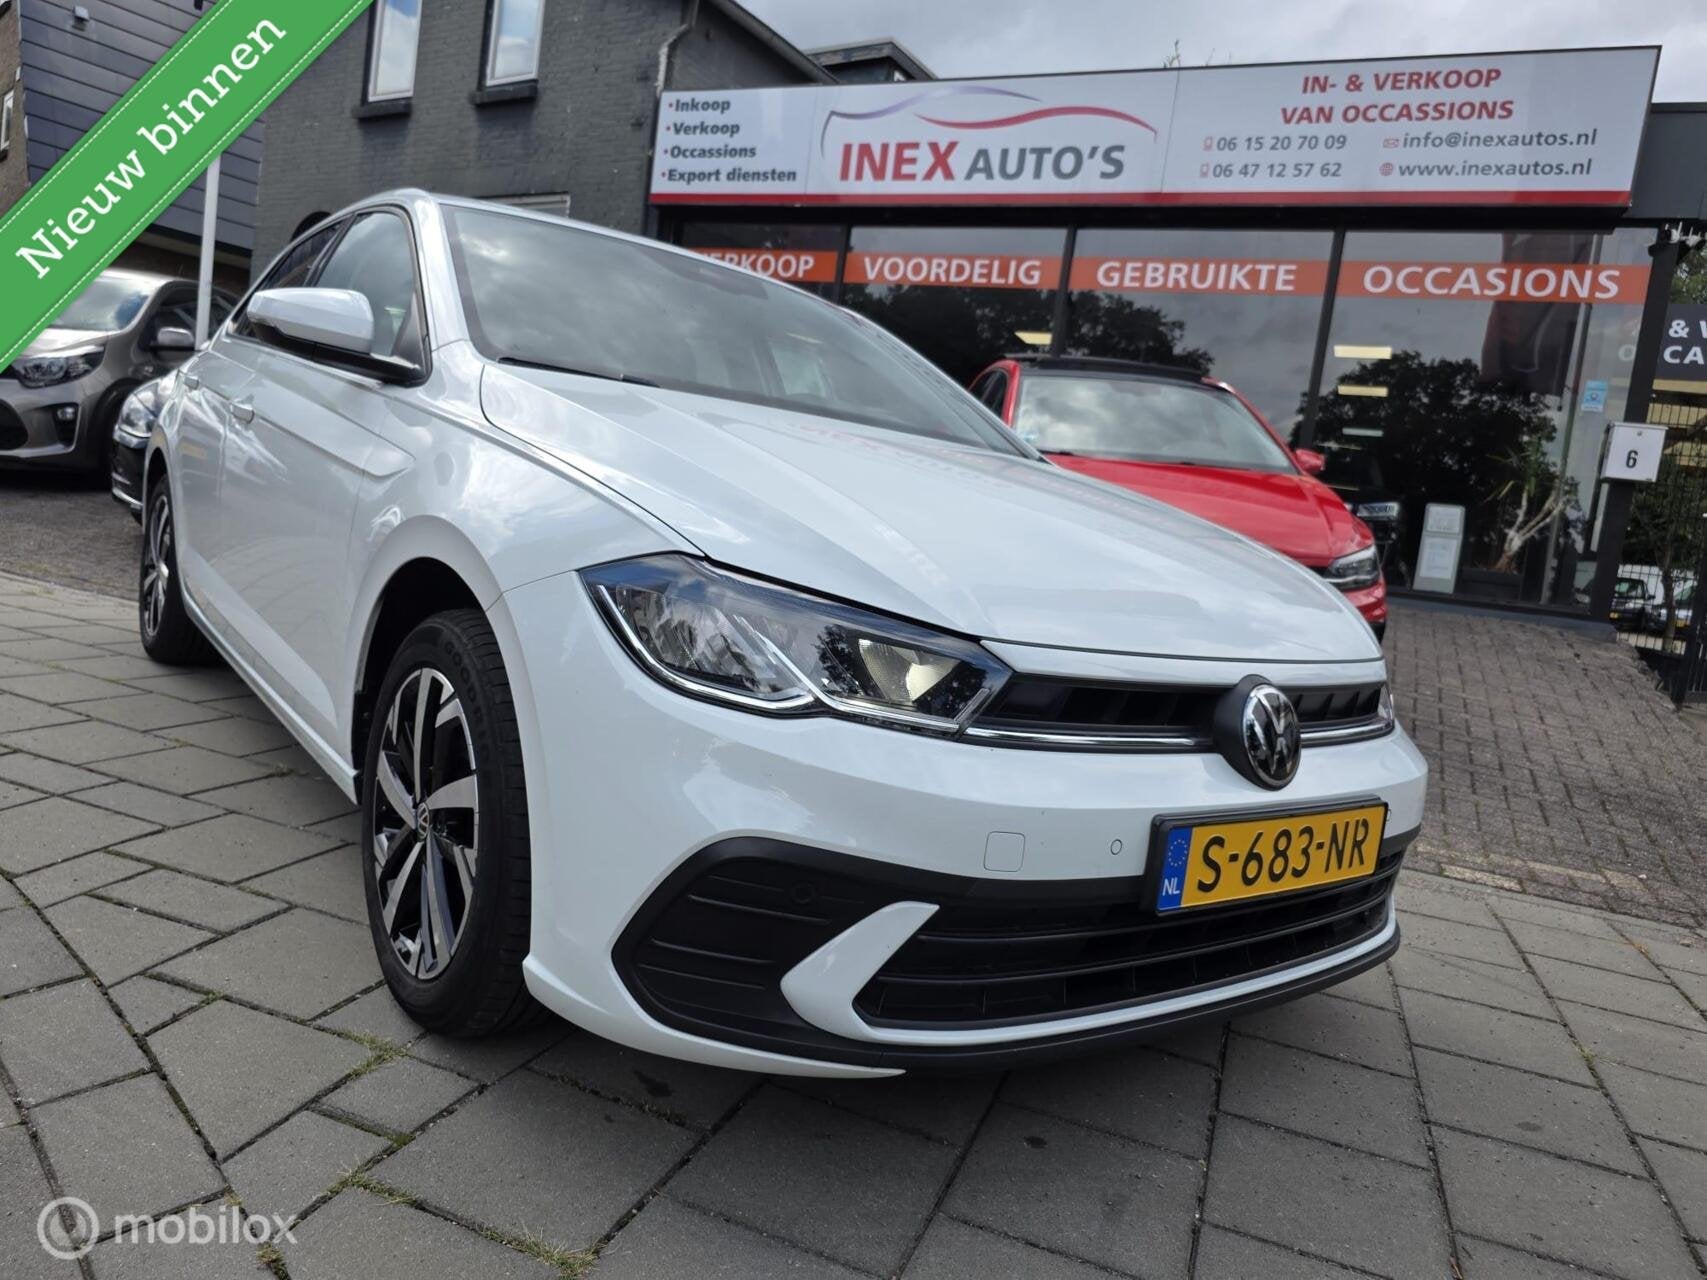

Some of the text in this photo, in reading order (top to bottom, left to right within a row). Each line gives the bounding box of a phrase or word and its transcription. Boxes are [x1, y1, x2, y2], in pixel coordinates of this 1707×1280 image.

[1301, 68, 1502, 95] IN- & VERKOOP
[674, 98, 731, 115] Inkoop
[1280, 99, 1515, 125] VAN OCCASSIONS
[673, 121, 741, 138] Verkoop
[1402, 128, 1598, 149] info@inexautos.nl
[669, 144, 757, 159] Occassions
[1216, 134, 1348, 152] 06 15 20 70 09
[839, 141, 1126, 182] INEX AUTO'S
[1212, 162, 1342, 178] 06 47 12 57 62
[1398, 158, 1593, 177] www.inexautos.nl
[667, 167, 797, 186] Export diensten
[702, 253, 815, 279] RKOOP
[863, 256, 1042, 286] VOORDELIG
[1096, 260, 1298, 291] GEBRUIKTE
[1362, 265, 1621, 299] OCCASIONS
[1668, 319, 1690, 338] &
[1625, 450, 1639, 469] 6
[1197, 818, 1369, 893] S-683-NR
[1162, 876, 1181, 896] NL
